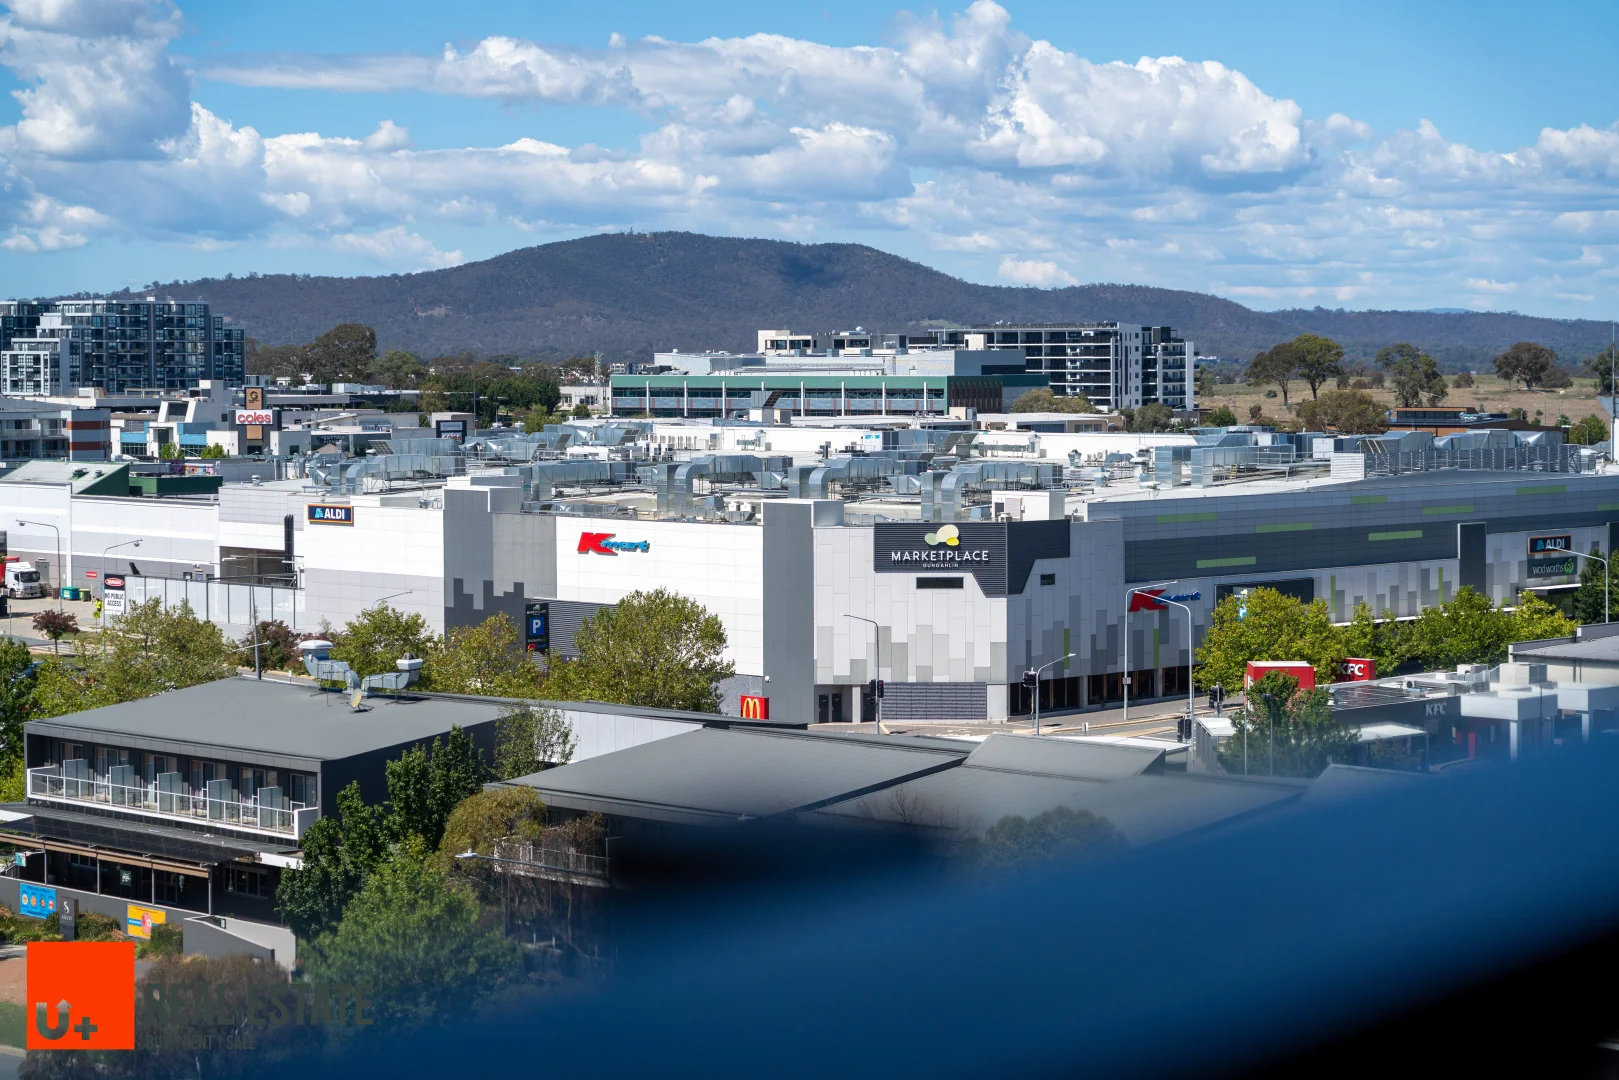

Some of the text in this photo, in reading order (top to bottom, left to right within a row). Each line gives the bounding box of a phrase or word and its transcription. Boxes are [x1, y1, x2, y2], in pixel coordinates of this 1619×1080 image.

[237, 411, 271, 423] coles
[324, 508, 345, 519] ALDI
[577, 531, 650, 556] Kmart
[1546, 539, 1565, 549] ALDI
[891, 550, 989, 561] MARKETPLACE
[532, 619, 542, 634] P
[1338, 663, 1365, 677] KFC
[1425, 703, 1447, 716] KFC
